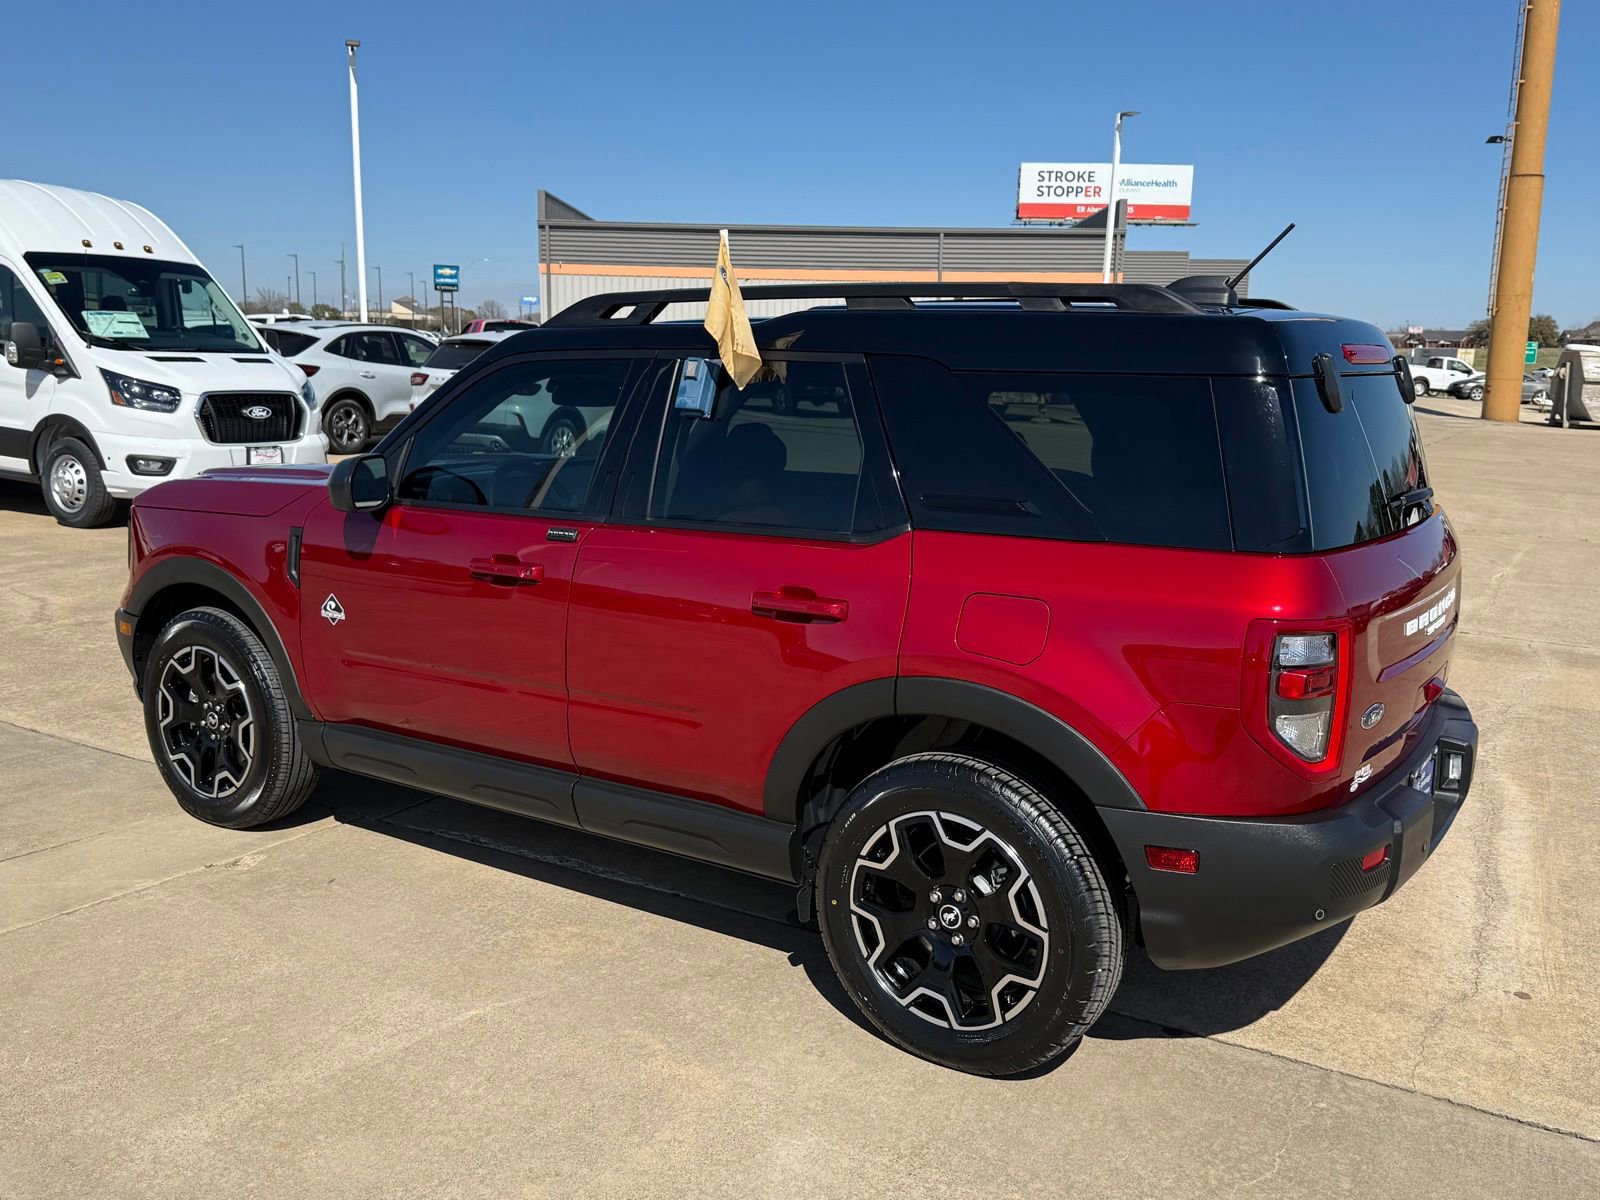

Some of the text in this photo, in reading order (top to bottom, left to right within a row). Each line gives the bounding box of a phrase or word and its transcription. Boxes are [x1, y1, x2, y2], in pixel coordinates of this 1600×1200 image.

[1037, 170, 1096, 183] STROKE
[1119, 178, 1178, 188] AllianceHealth
[1036, 185, 1102, 197] STOPPER
